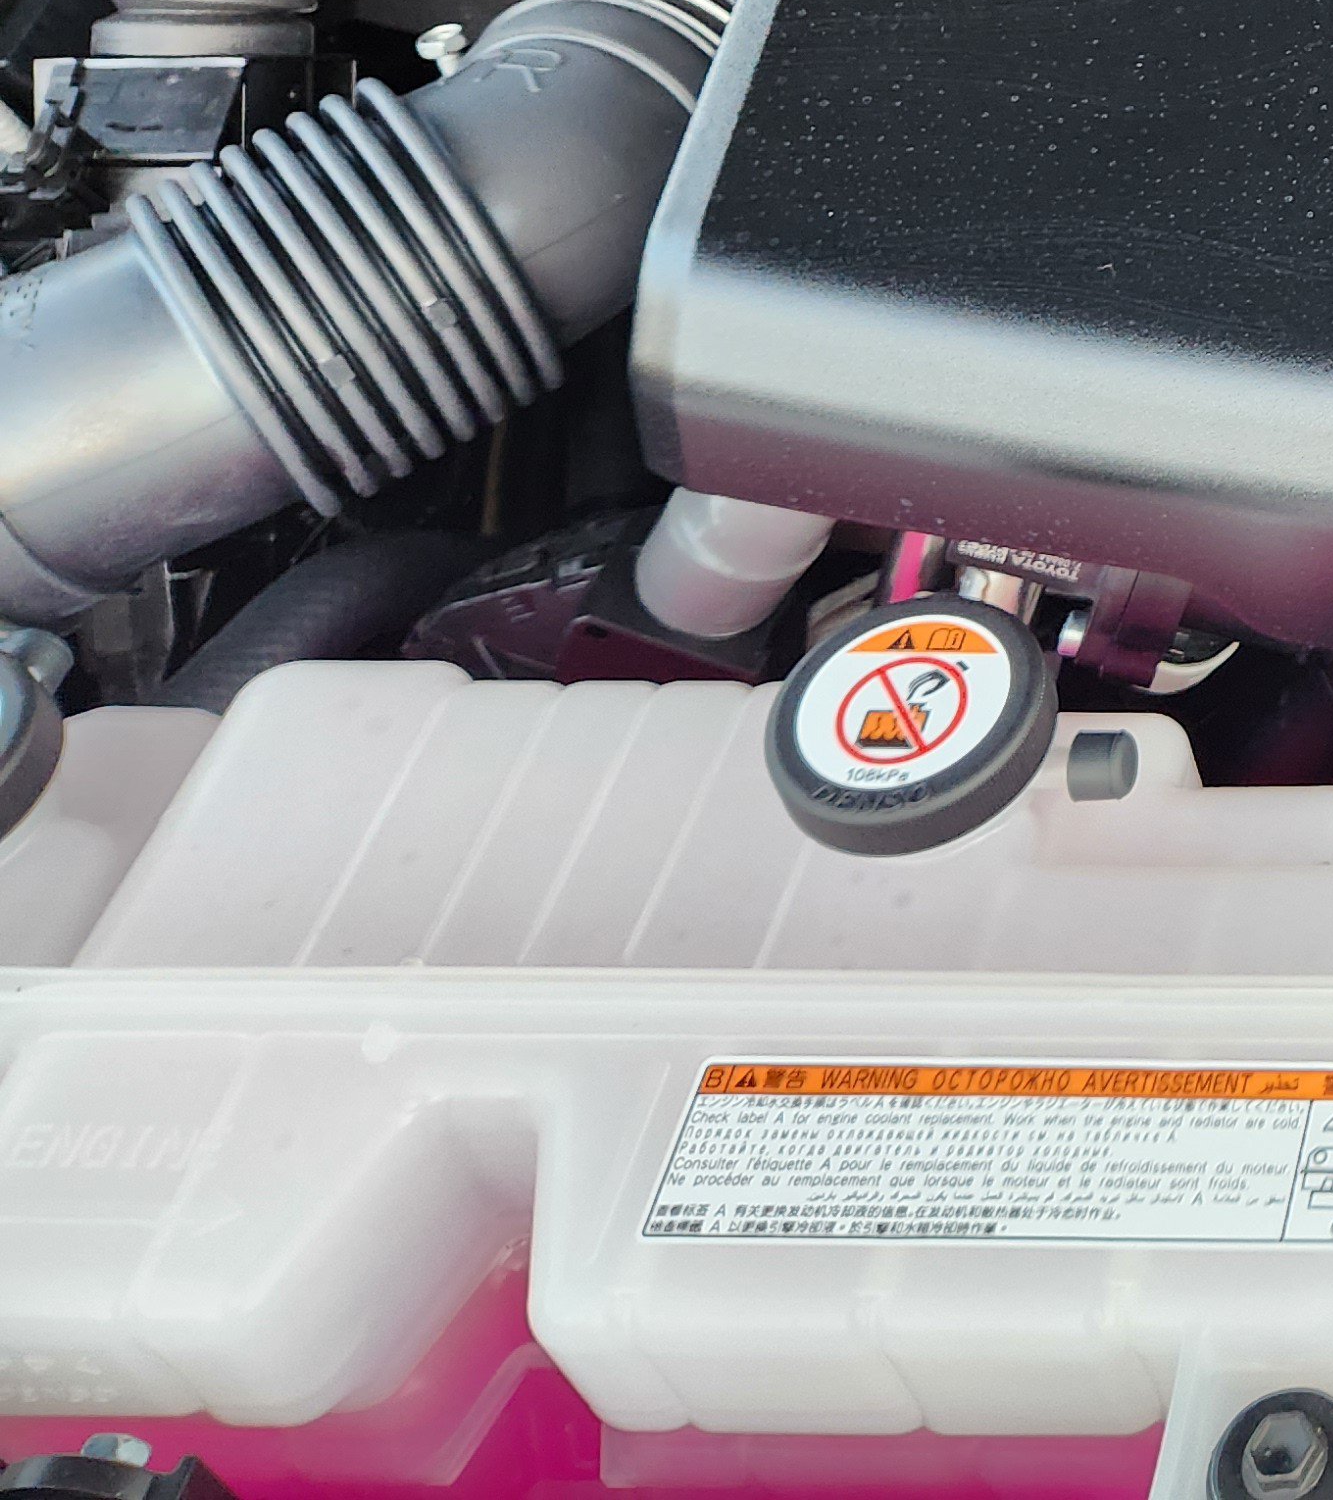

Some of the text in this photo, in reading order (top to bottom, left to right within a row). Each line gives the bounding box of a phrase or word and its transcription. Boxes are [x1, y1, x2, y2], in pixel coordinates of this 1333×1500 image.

[1011, 553, 1082, 584] TOYOTA
[705, 1068, 726, 1089] B
[763, 1068, 807, 1089] 警告
[821, 1068, 919, 1090] WARNING
[932, 1068, 1072, 1092] ОСТОРОЖНО
[1081, 1071, 1254, 1094] AVERTISSEMENT
[691, 1110, 731, 1125] Check
[737, 1110, 769, 1124] label
[774, 1112, 785, 1124] A
[792, 1112, 810, 1124] for
[817, 1112, 858, 1127] engine
[865, 1113, 912, 1126] coolant
[1003, 1114, 1035, 1127] Work
[1043, 1114, 1077, 1127] when
[1083, 1114, 1104, 1127] the
[1111, 1116, 1152, 1130] engine
[1158, 1115, 1183, 1128] and
[1189, 1115, 1238, 1129] radiator
[1245, 1117, 1267, 1129] are
[684, 1125, 753, 1140] Порядок
[761, 1128, 819, 1140] замены
[777, 1143, 827, 1156] когда
[832, 1144, 921, 1157] двигатель
[946, 1145, 1025, 1158] радиатор
[673, 1155, 740, 1170] Consulter
[746, 1155, 813, 1173] l'étiquette
[819, 1157, 831, 1169] A
[839, 1159, 873, 1173] pour
[879, 1157, 892, 1170] le
[899, 1158, 993, 1173] remplacement
[1001, 1158, 1020, 1172] du
[1026, 1158, 1072, 1174] liquide
[1080, 1159, 1097, 1172] de
[1104, 1159, 1208, 1174] refroidissement
[1215, 1160, 1234, 1174] du
[666, 1172, 686, 1186] Ne
[692, 1171, 755, 1188] procéder
[761, 1174, 780, 1186] au
[788, 1173, 882, 1188] remplacement
[889, 1176, 916, 1189] que
[923, 1175, 974, 1189] lorsque
[982, 1174, 995, 1187] le
[1002, 1176, 1049, 1188] moteur
[1057, 1176, 1072, 1188] et
[1079, 1176, 1091, 1188] le
[1099, 1176, 1162, 1189] radiateur
[1169, 1177, 1200, 1190] sont
[713, 1204, 727, 1217] A
[708, 1220, 722, 1233] A
